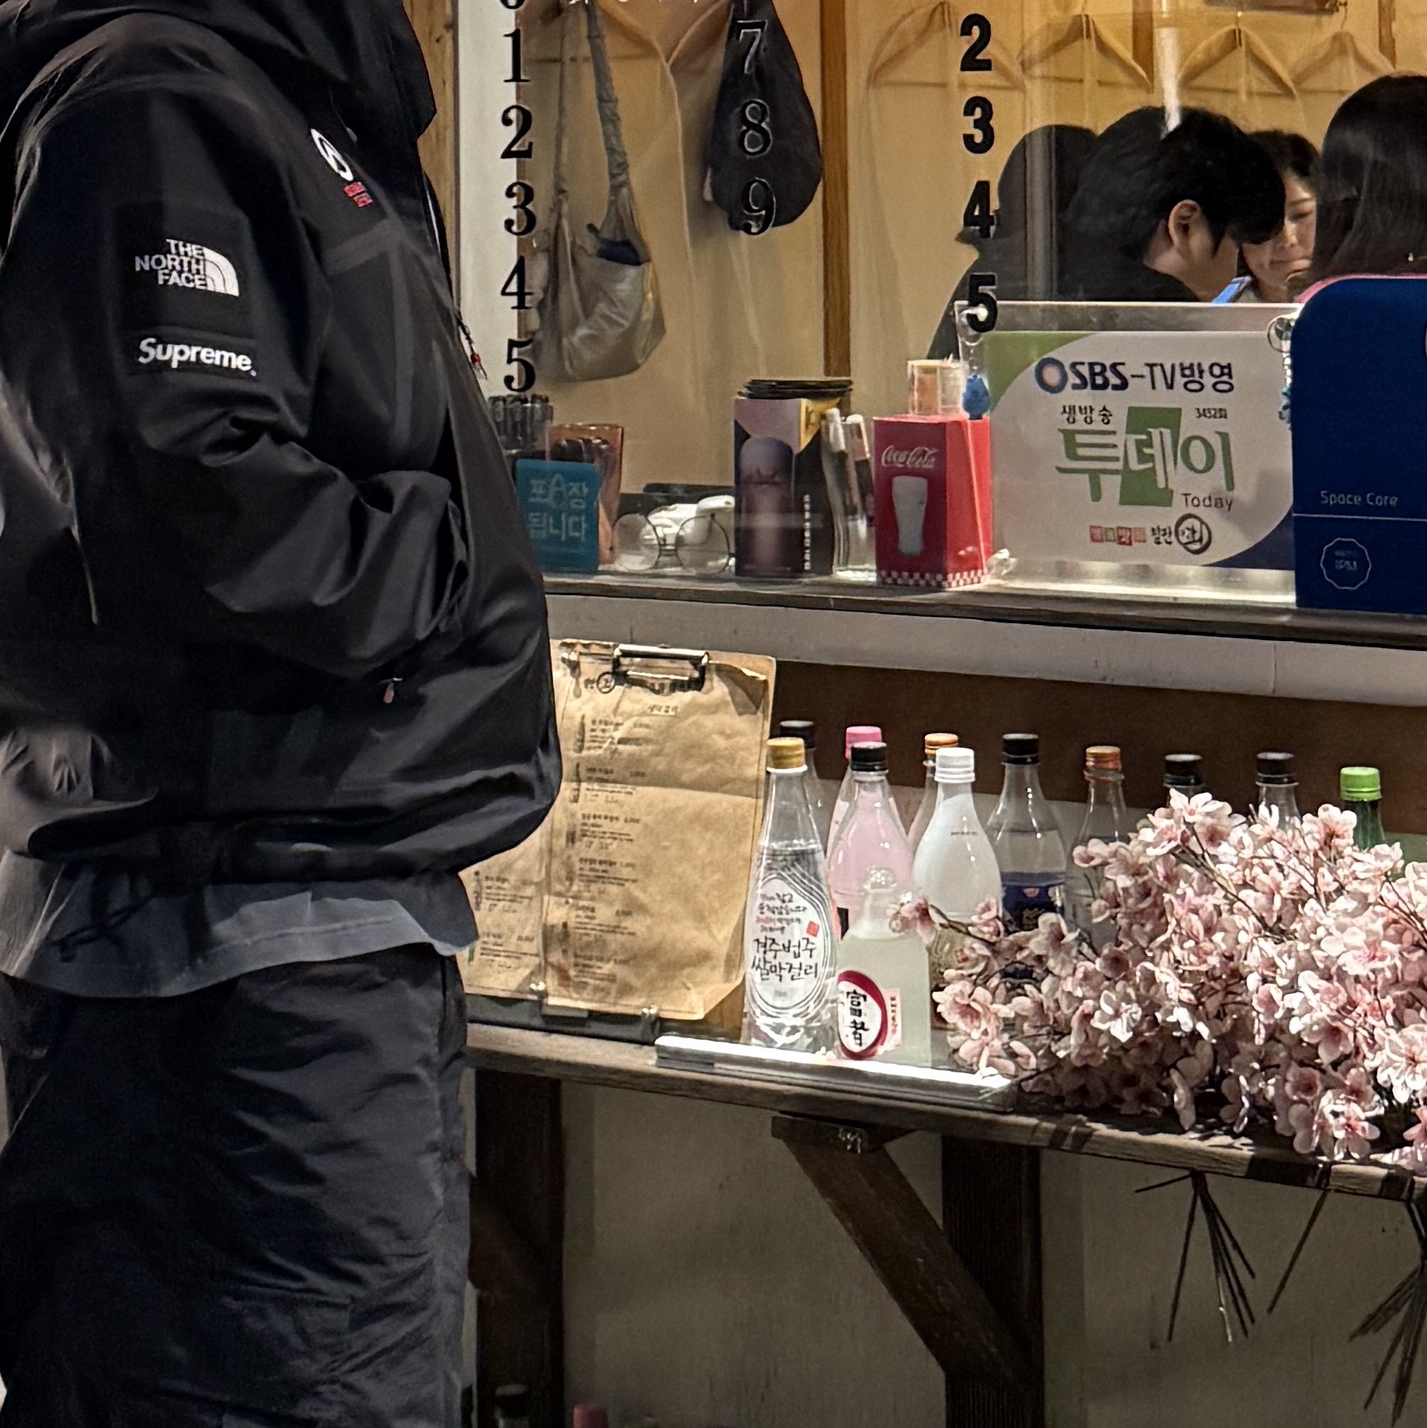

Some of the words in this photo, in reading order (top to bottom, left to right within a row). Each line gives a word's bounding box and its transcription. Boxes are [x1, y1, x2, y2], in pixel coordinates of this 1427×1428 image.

[503, 29, 531, 83] 1
[736, 20, 768, 74] 7
[960, 14, 992, 72] 2
[501, 105, 533, 159] 2
[741, 99, 772, 156] 8
[963, 96, 995, 154] 3
[504, 182, 537, 236] 3
[742, 177, 775, 235] 9
[963, 180, 995, 239] 4
[135, 255, 206, 275] NORTH
[166, 239, 205, 259] THE
[158, 270, 208, 289] FACE
[501, 256, 532, 310] 4
[967, 273, 998, 333] 5
[138, 338, 253, 372] Supreme
[503, 339, 535, 392] 5
[1061, 405, 1113, 425] 생방송
[1055, 428, 1235, 503] 투데이
[529, 512, 588, 541] 됩니다
[1181, 493, 1234, 512] Today
[752, 955, 818, 982] 쌀막걸리
[753, 936, 816, 959] 경주법주
